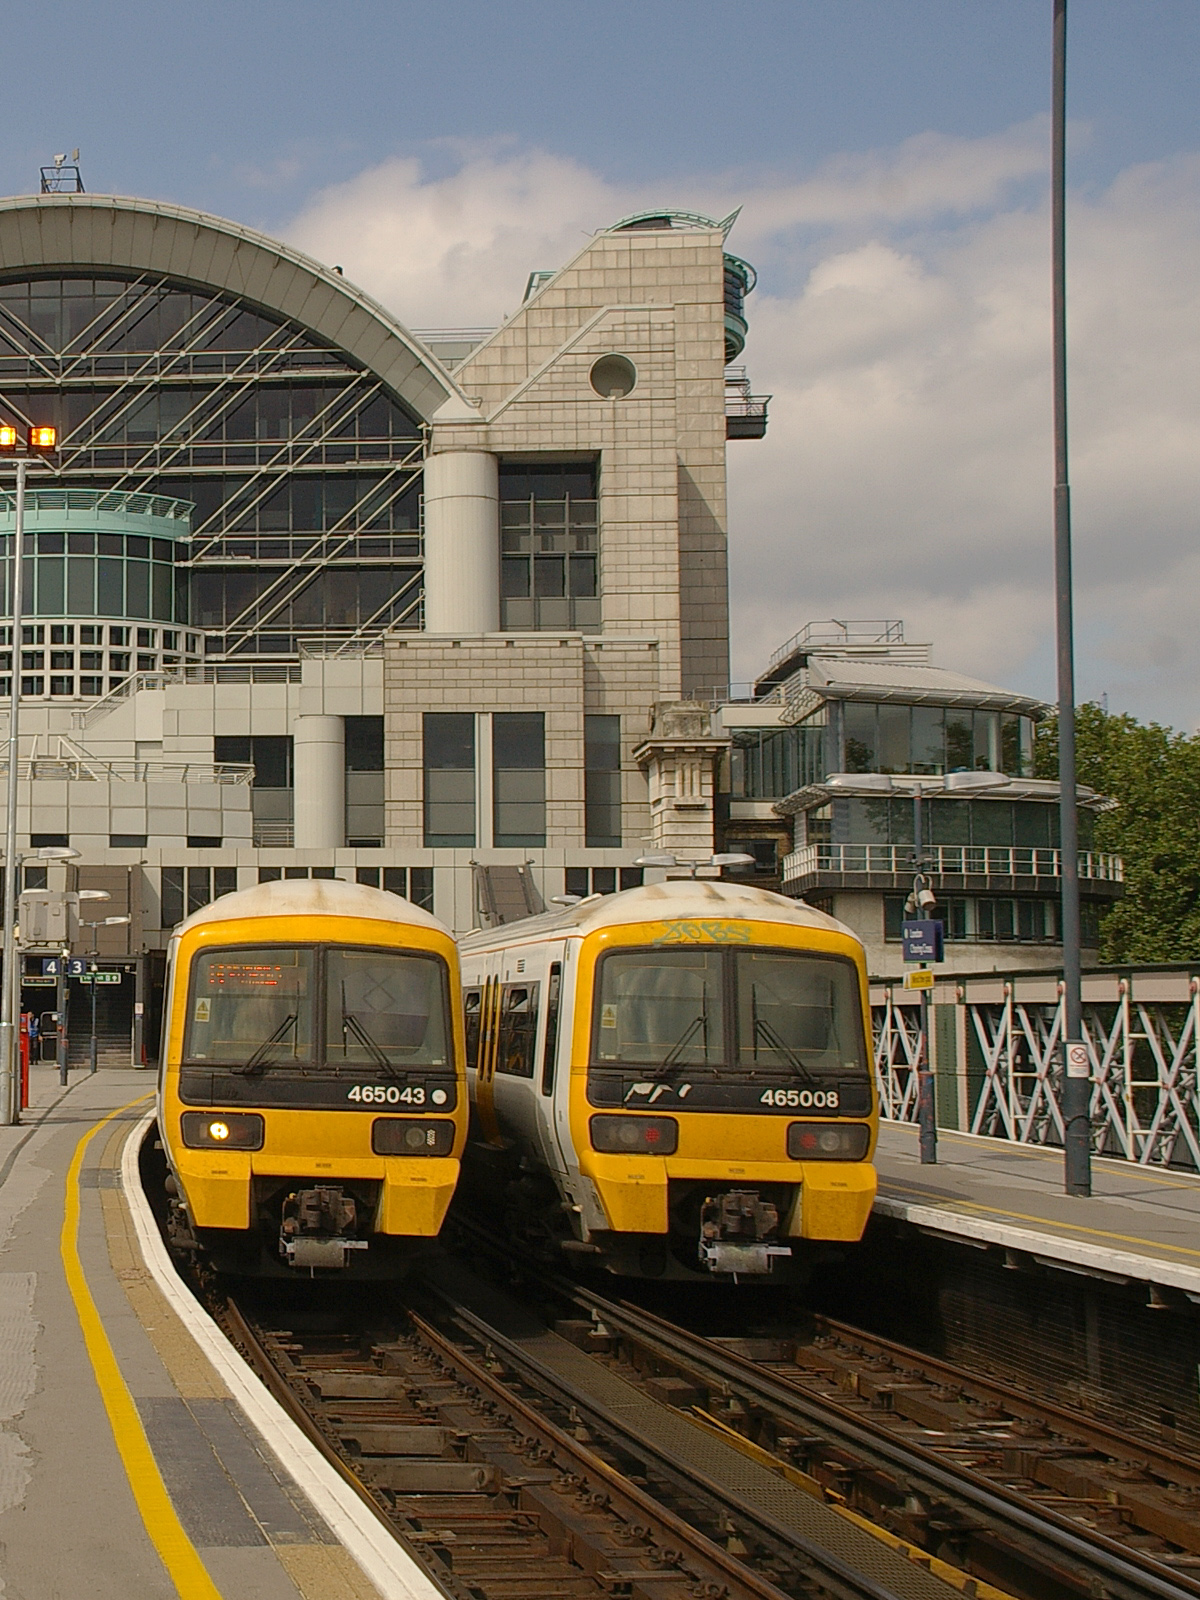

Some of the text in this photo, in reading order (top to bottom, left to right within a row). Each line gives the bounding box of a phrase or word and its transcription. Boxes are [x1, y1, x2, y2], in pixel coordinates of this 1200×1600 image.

[46, 961, 57, 974] 4
[72, 961, 82, 974] 3
[347, 1085, 426, 1105] 465043
[760, 1089, 839, 1108] 465008
